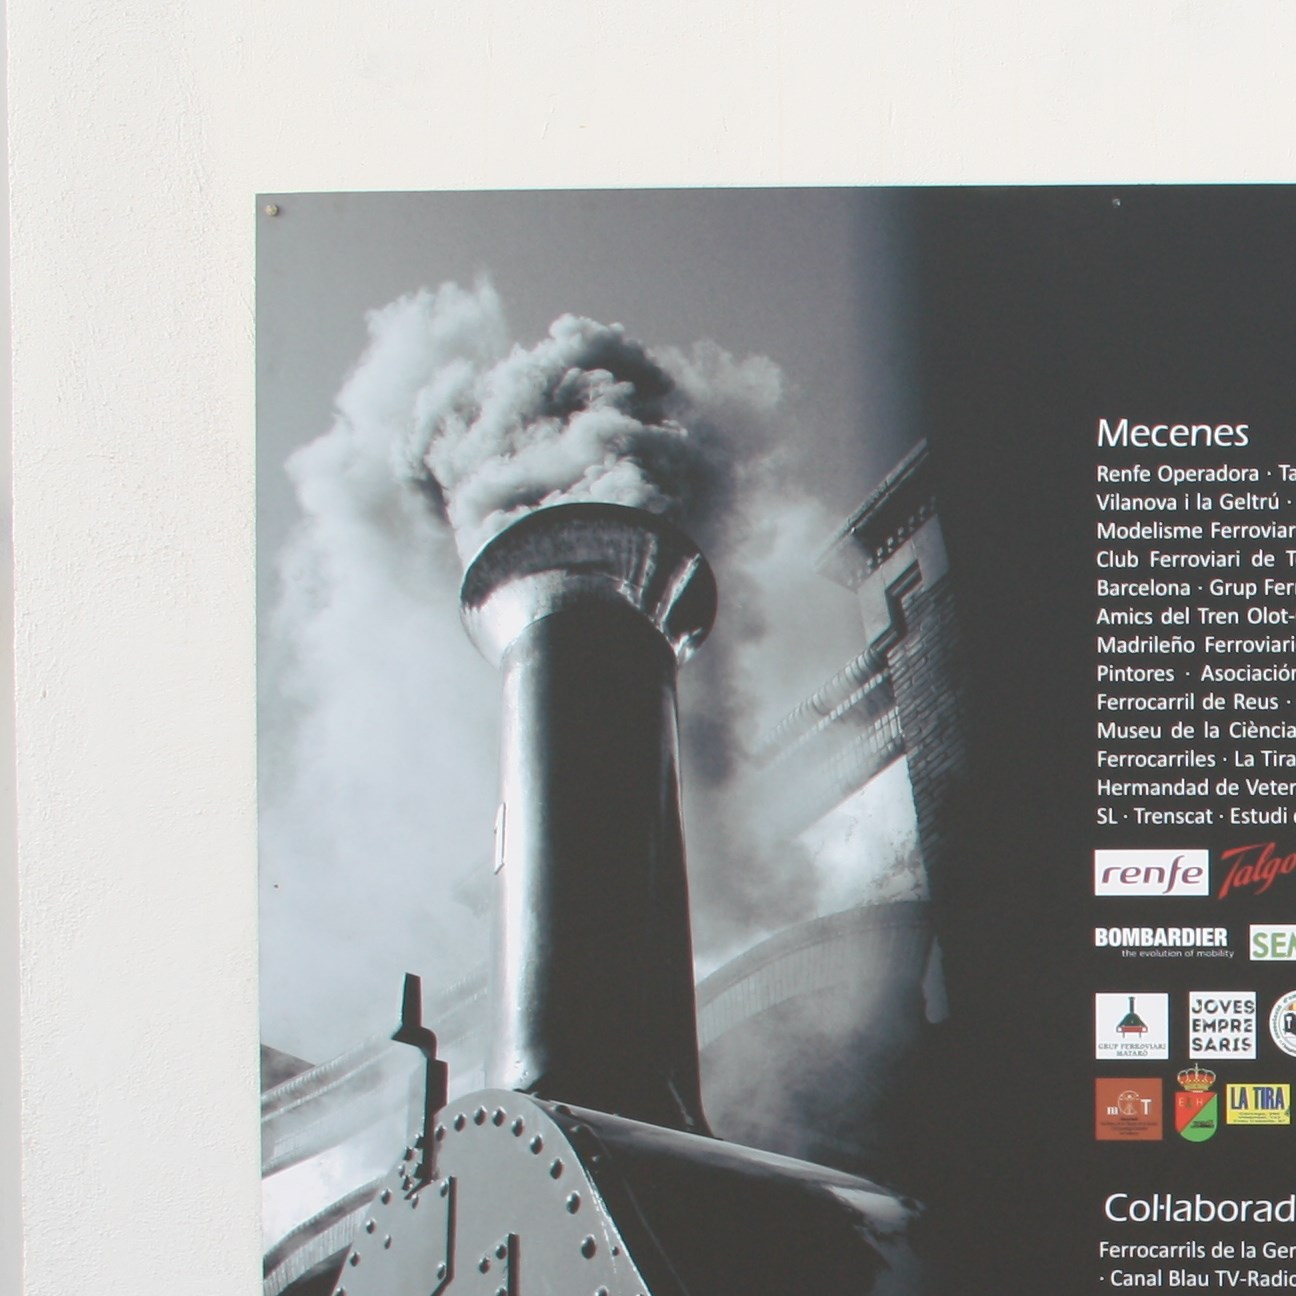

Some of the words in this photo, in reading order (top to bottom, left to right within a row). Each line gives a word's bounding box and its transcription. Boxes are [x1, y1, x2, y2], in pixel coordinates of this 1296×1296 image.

[1097, 418, 1249, 448] Mecenes
[1097, 464, 1151, 483] Renfe
[1157, 463, 1259, 486] Operadora
[1096, 807, 1119, 825] SL
[1133, 807, 1214, 825] Trenscat
[1230, 806, 1288, 825] Estudi
[1102, 855, 1203, 894] renfe
[1095, 927, 1228, 947] BOMBARDIER
[1122, 949, 1138, 958] the
[1139, 949, 1183, 958] evolution
[1231, 1086, 1249, 1110] LA
[1253, 1086, 1286, 1110] TIRA
[1099, 1240, 1206, 1259] Ferrocarrils
[1211, 1240, 1235, 1259] de
[1241, 1240, 1257, 1259] la
[1110, 1268, 1162, 1287] Canal
[1168, 1268, 1209, 1287] Blau
